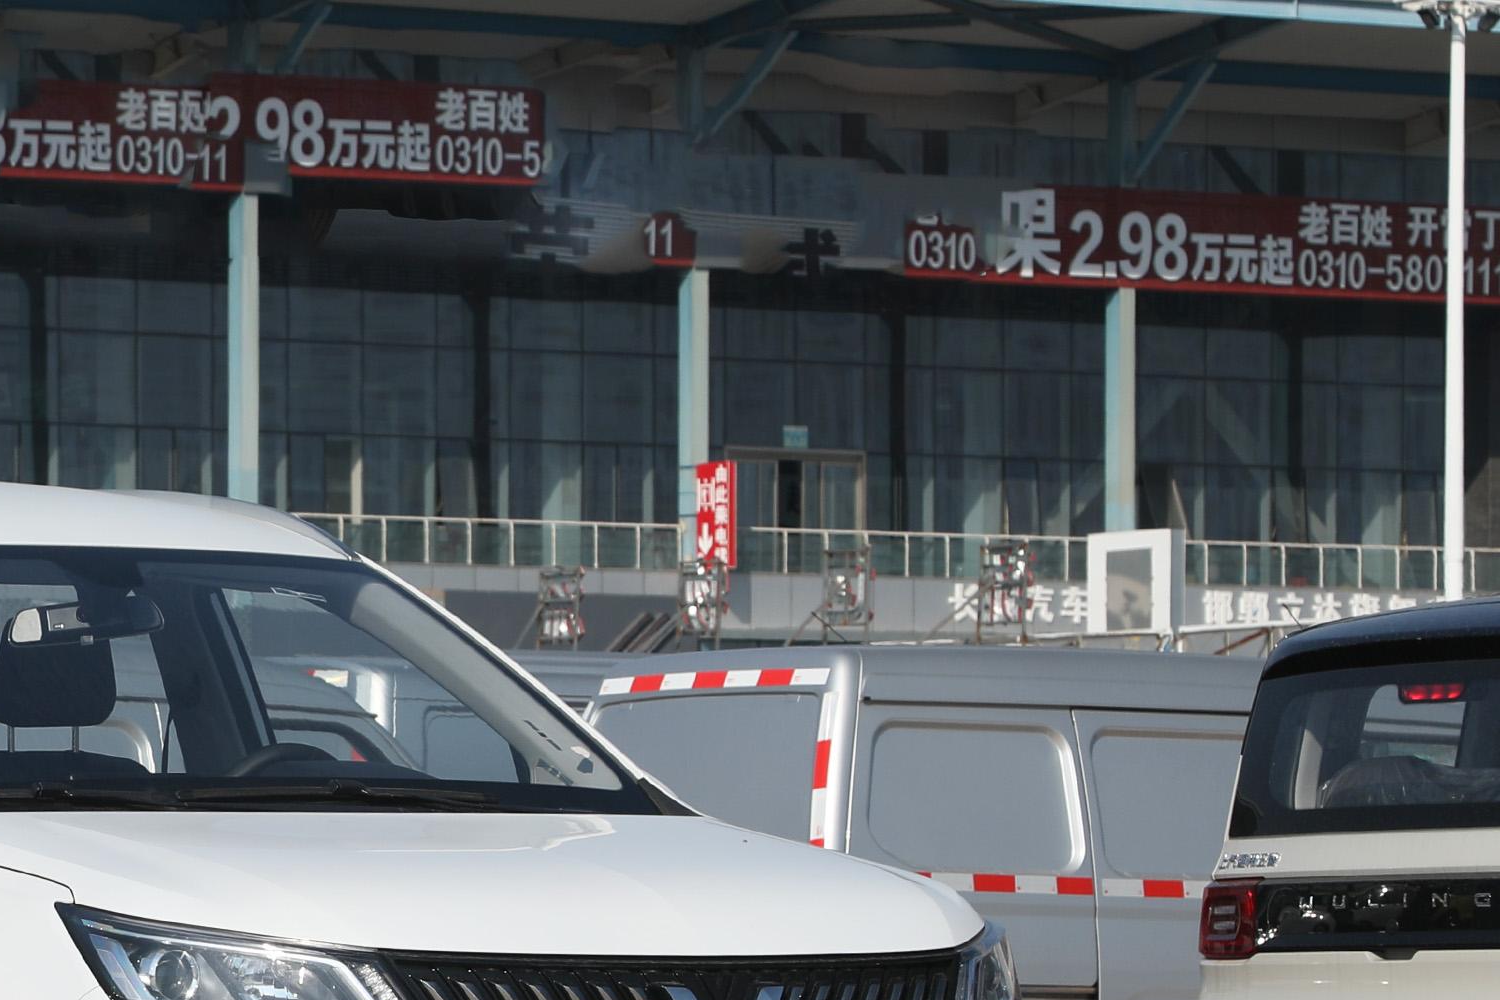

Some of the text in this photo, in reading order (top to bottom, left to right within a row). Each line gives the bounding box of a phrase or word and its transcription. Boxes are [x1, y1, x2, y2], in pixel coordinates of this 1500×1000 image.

[435, 87, 530, 134] 老百姓
[644, 219, 674, 257] 11
[1297, 202, 1393, 248] 老百姓
[908, 230, 976, 271] 0310
[947, 583, 1088, 624] 长汽车
